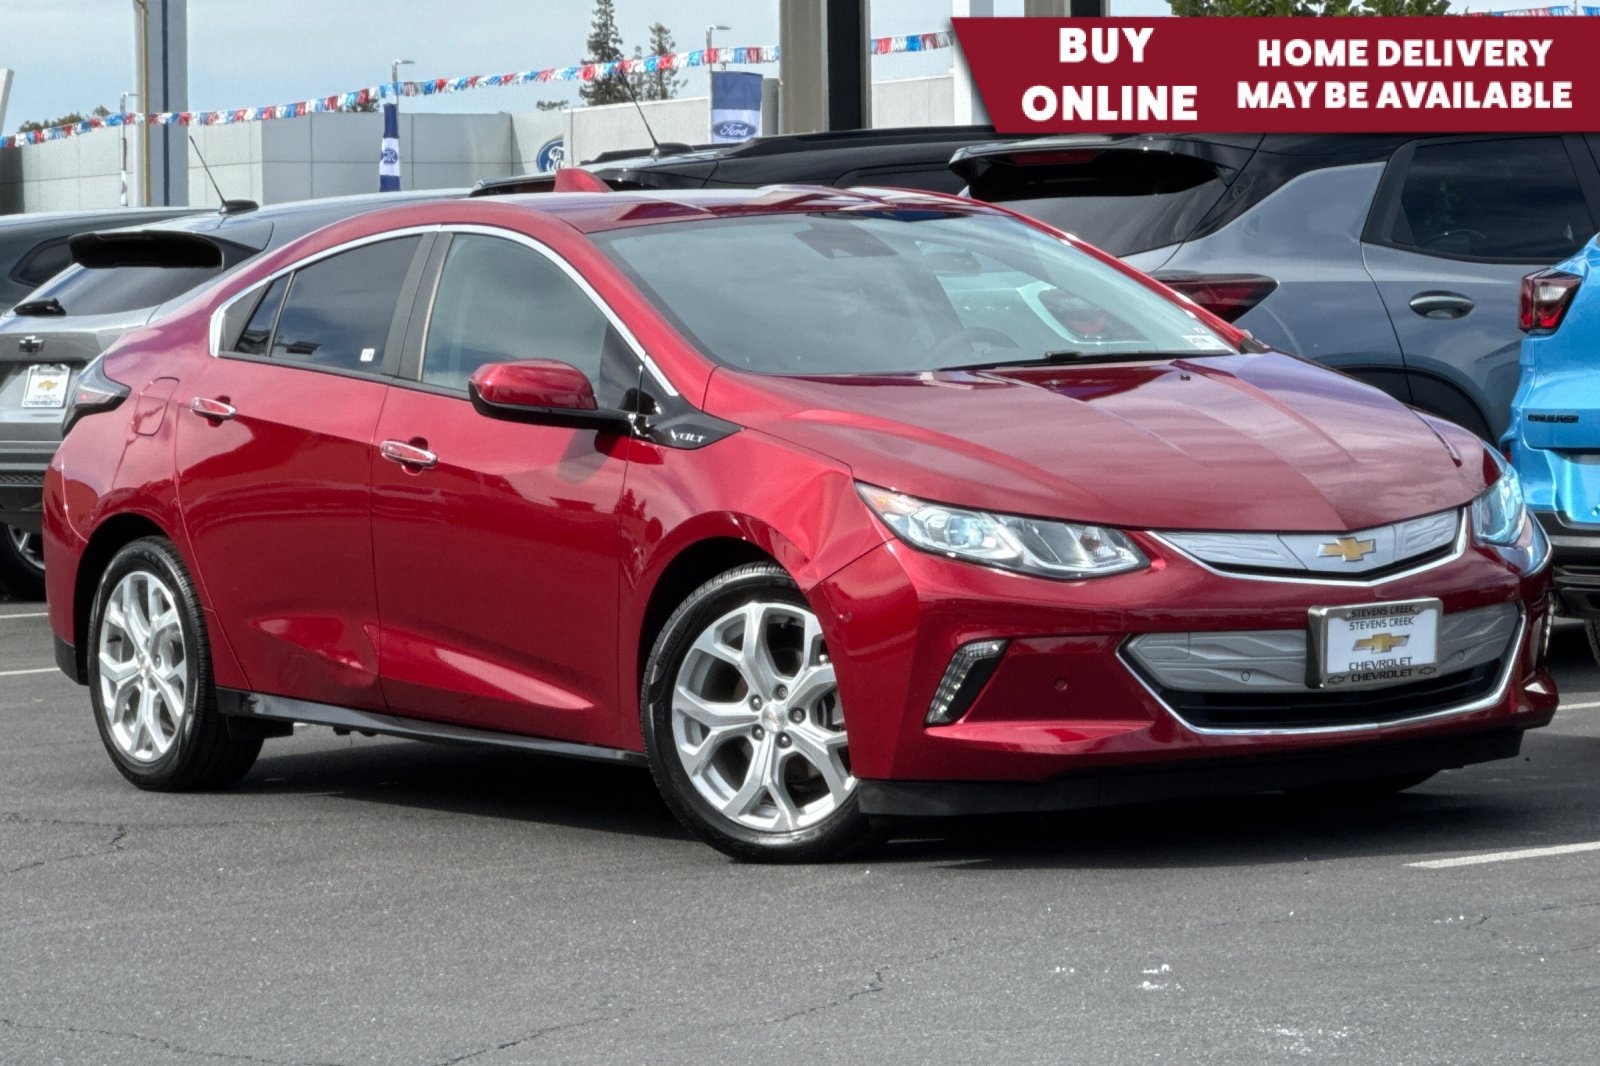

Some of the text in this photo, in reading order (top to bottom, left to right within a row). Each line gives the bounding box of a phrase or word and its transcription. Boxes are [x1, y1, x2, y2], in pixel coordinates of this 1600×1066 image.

[720, 122, 748, 136] Ford
[1350, 604, 1415, 618] STEVENS CREEK
[1349, 616, 1415, 631] STEVENS CREEK
[1348, 656, 1413, 671] CHEVROLET
[1351, 668, 1413, 682] CHEVROLET
